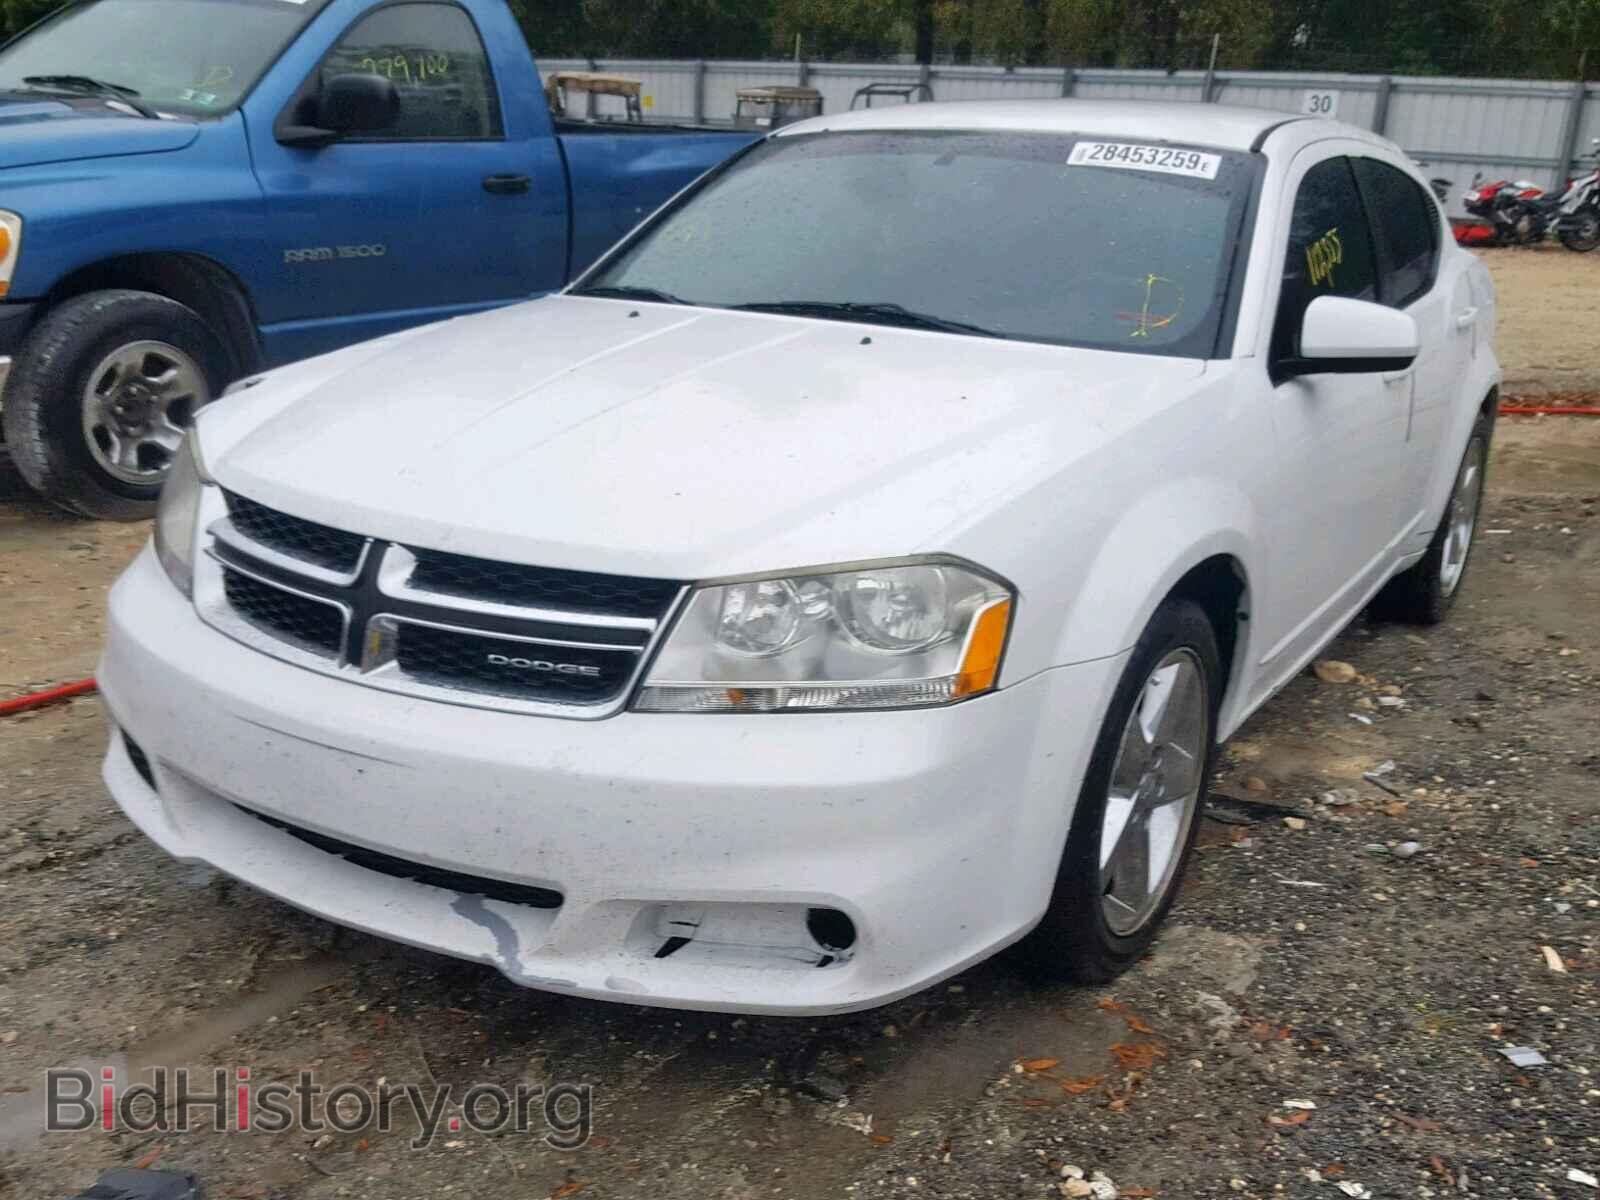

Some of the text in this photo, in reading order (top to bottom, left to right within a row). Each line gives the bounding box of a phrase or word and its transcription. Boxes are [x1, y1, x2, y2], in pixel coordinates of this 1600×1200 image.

[1310, 94, 1332, 113] 30
[283, 244, 386, 263] RAM 1500
[487, 653, 601, 676] DODGE
